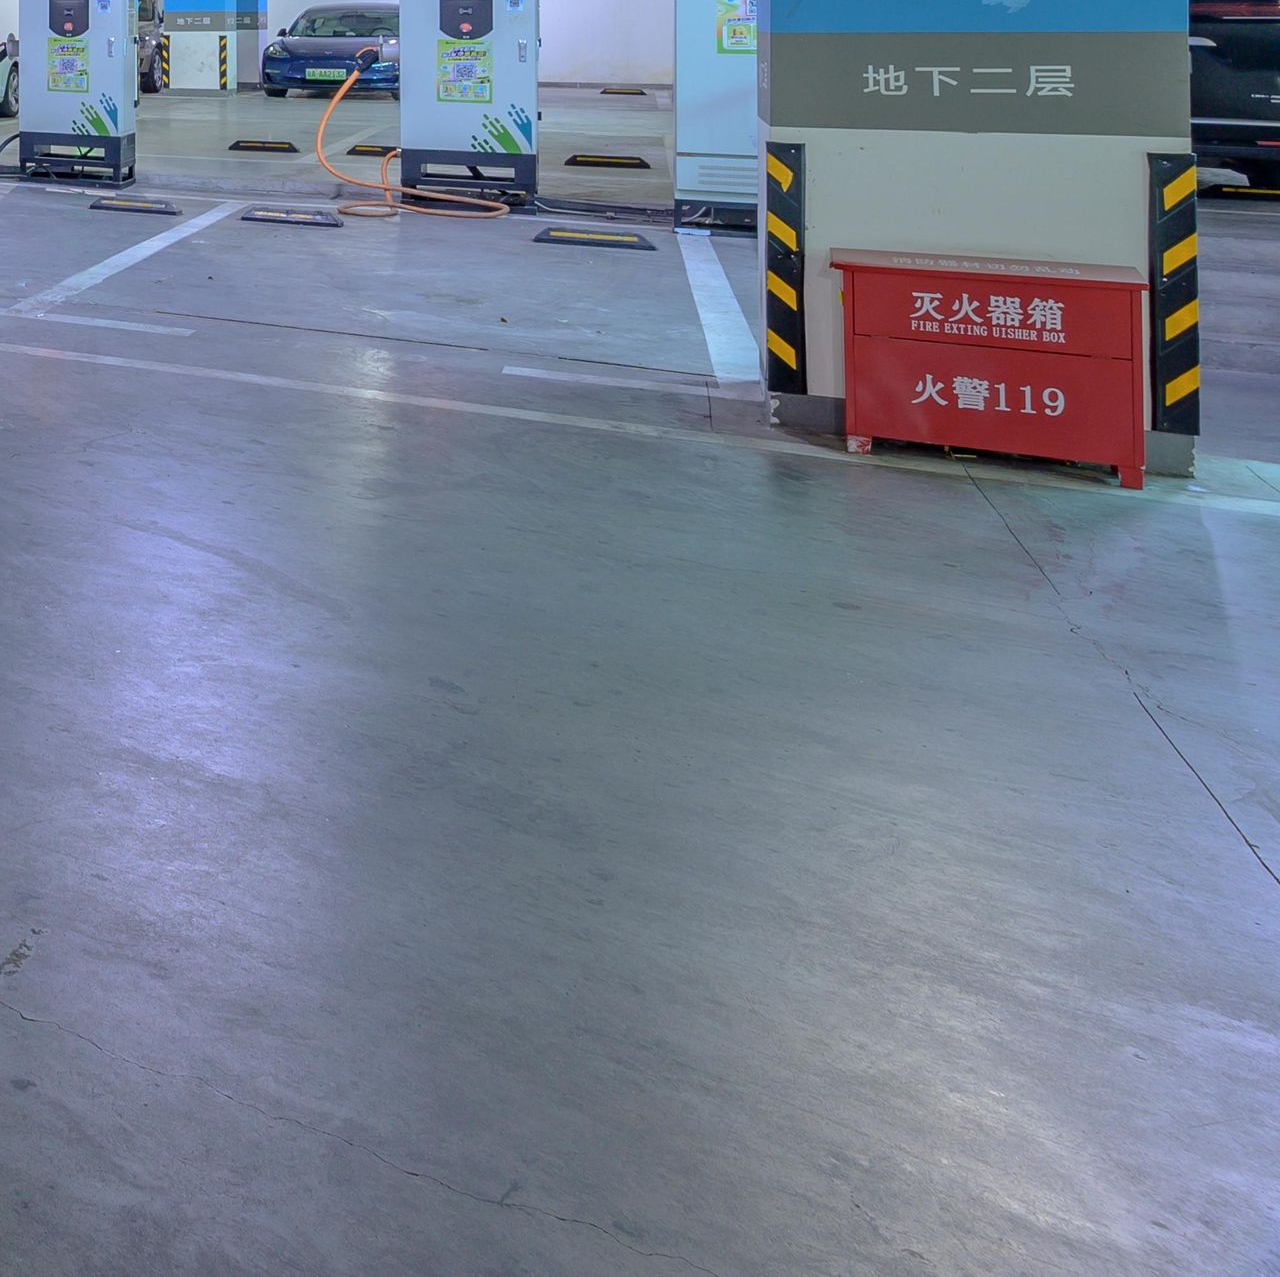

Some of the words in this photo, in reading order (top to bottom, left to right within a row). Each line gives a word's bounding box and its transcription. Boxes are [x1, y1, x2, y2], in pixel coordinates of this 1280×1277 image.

[862, 64, 1075, 97] 地下二层
[910, 291, 1065, 330] 灭火器箱
[911, 320, 940, 333] FIRE
[944, 322, 988, 337] EXTING
[992, 326, 1037, 342] UISHER
[1042, 330, 1066, 343] BOX
[911, 373, 1066, 416] 火警119
